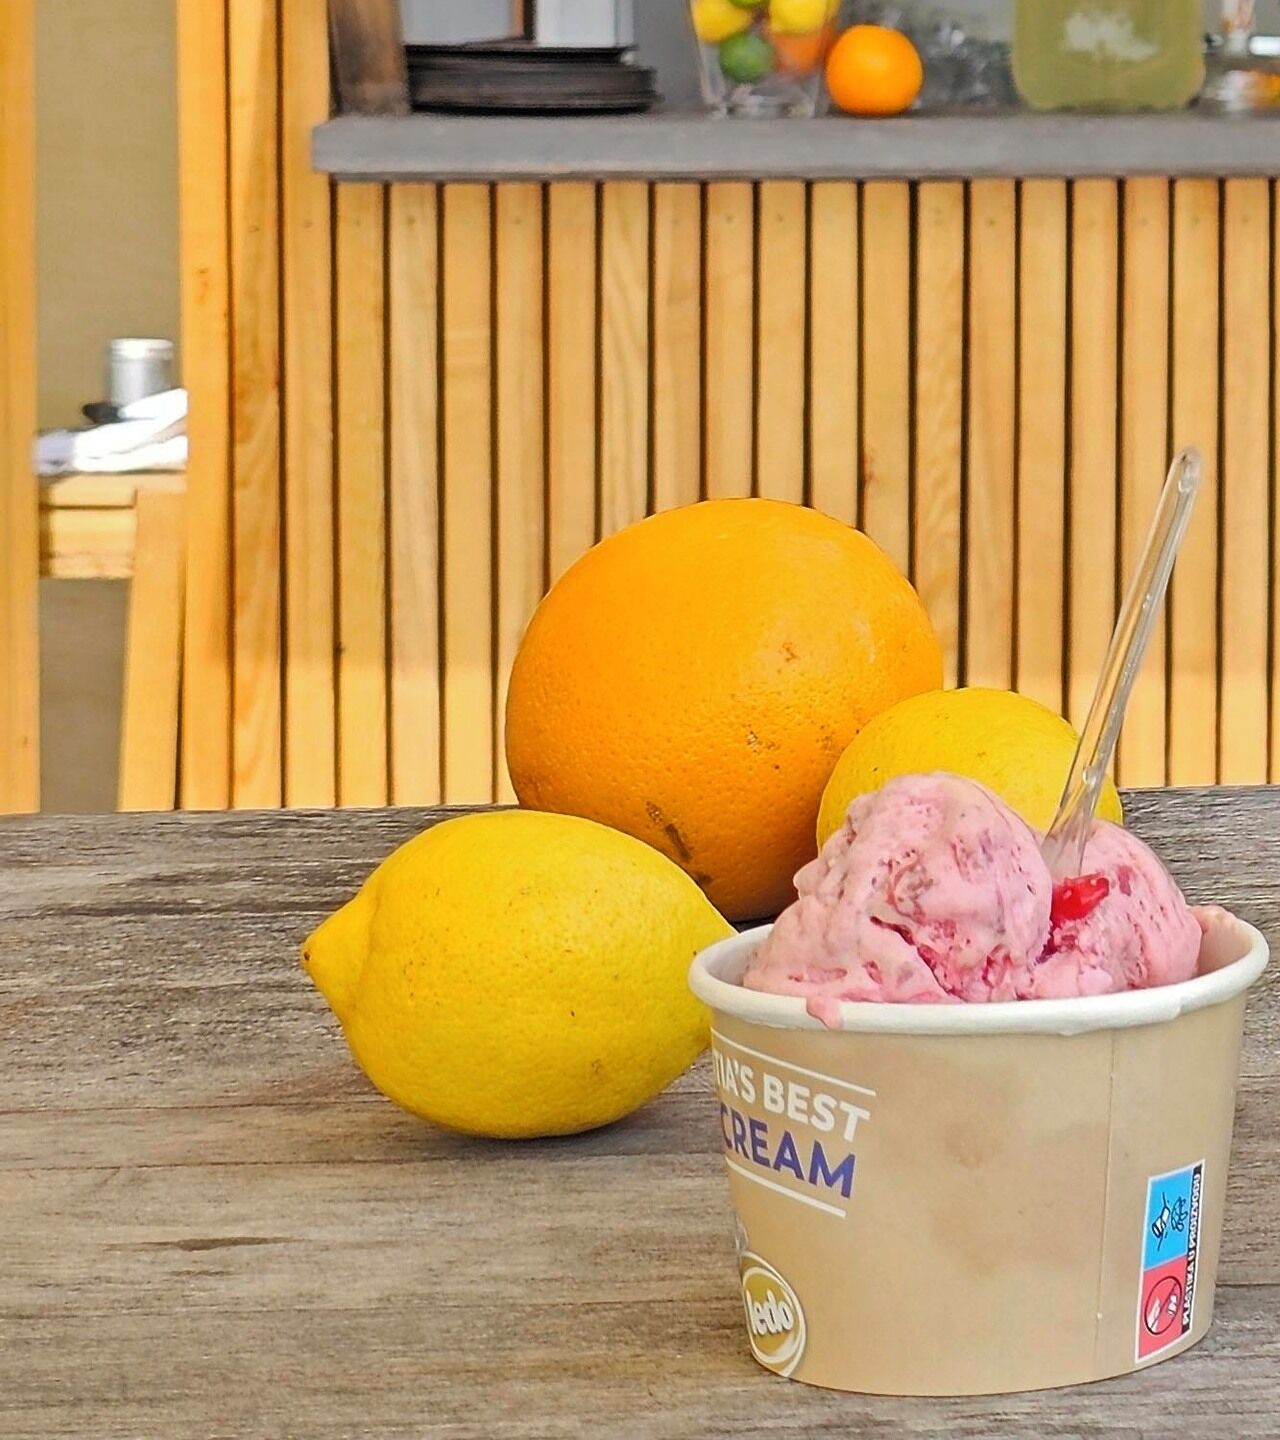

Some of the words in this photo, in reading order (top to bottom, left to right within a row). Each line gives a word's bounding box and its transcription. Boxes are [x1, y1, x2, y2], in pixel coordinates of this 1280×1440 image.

[762, 1071, 872, 1143] BEST
[719, 1101, 857, 1199] CREAM
[1187, 1172, 1202, 1250] PROIZVODU
[745, 1289, 795, 1337] ledo
[1181, 1262, 1197, 1326] PLASTIKA
